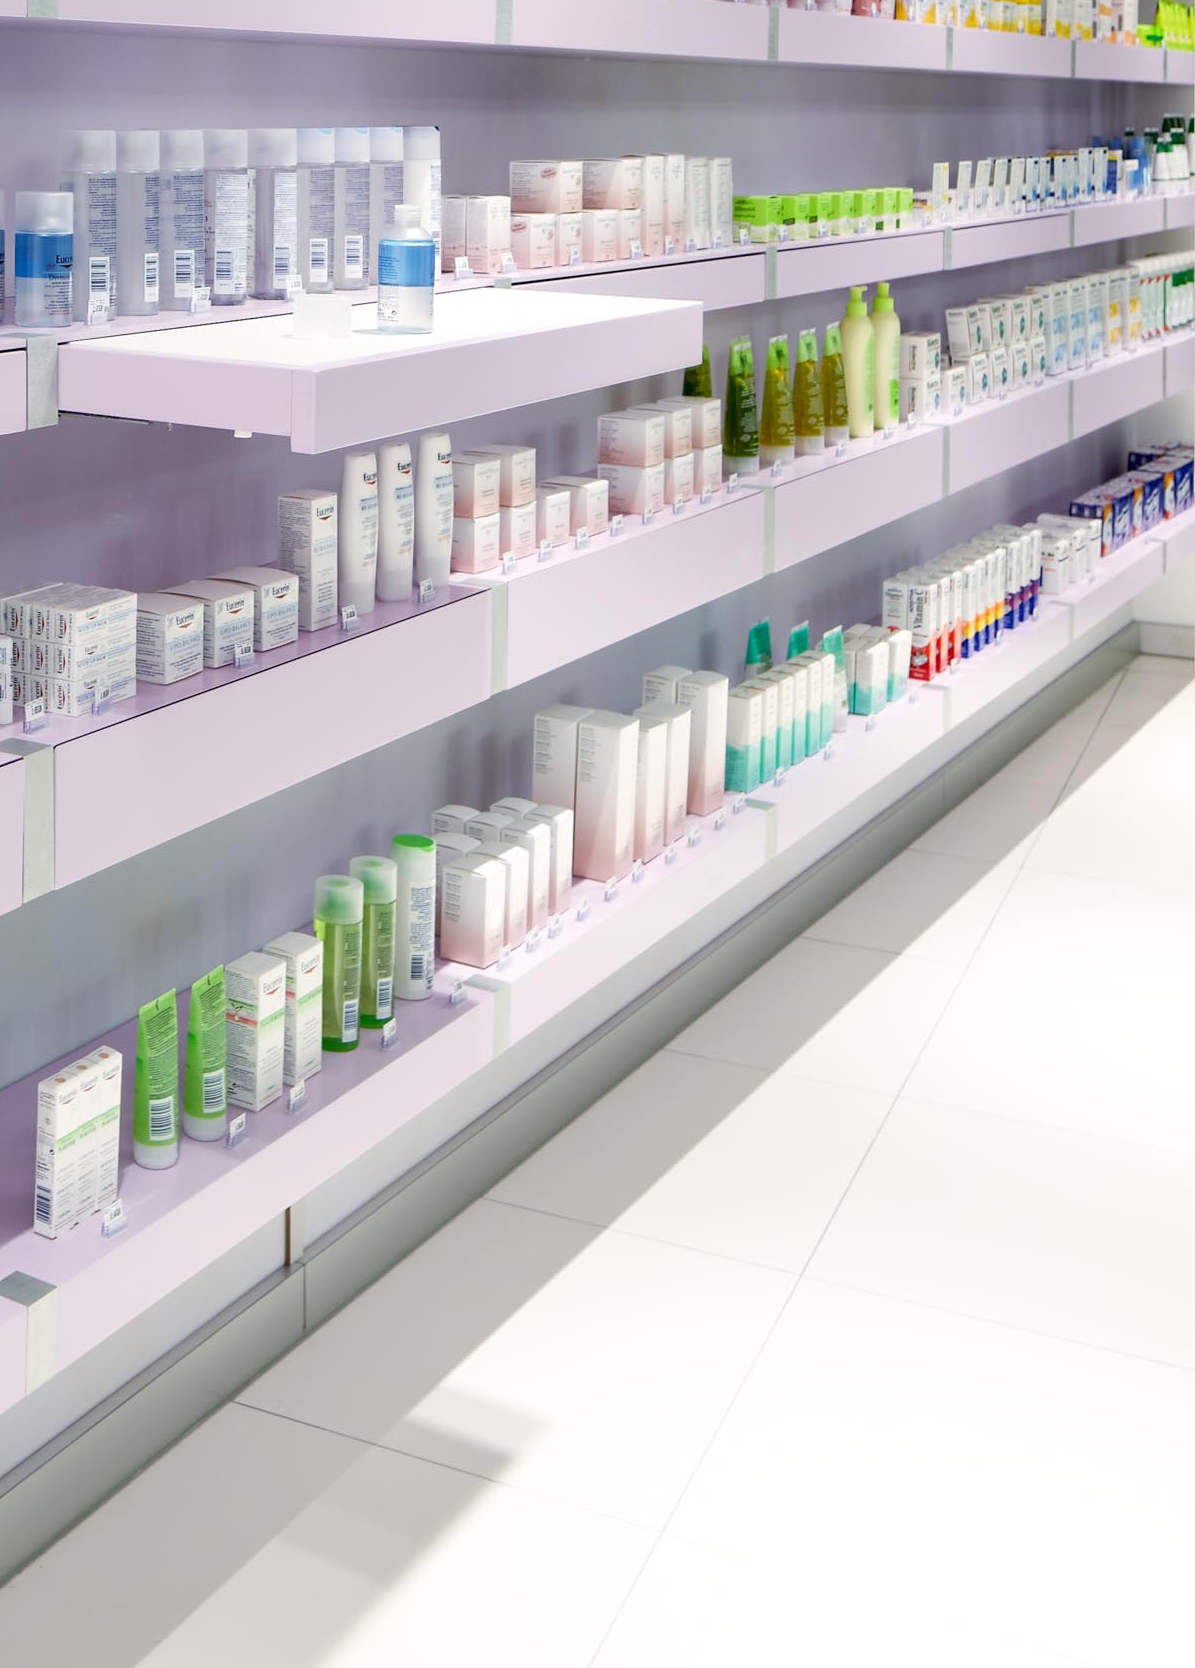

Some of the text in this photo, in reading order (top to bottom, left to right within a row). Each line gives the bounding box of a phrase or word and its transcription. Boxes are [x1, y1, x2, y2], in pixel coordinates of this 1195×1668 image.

[272, 584, 290, 596] Eucerin
[226, 599, 245, 611] Eucerin
[176, 613, 194, 625] Eucerin
